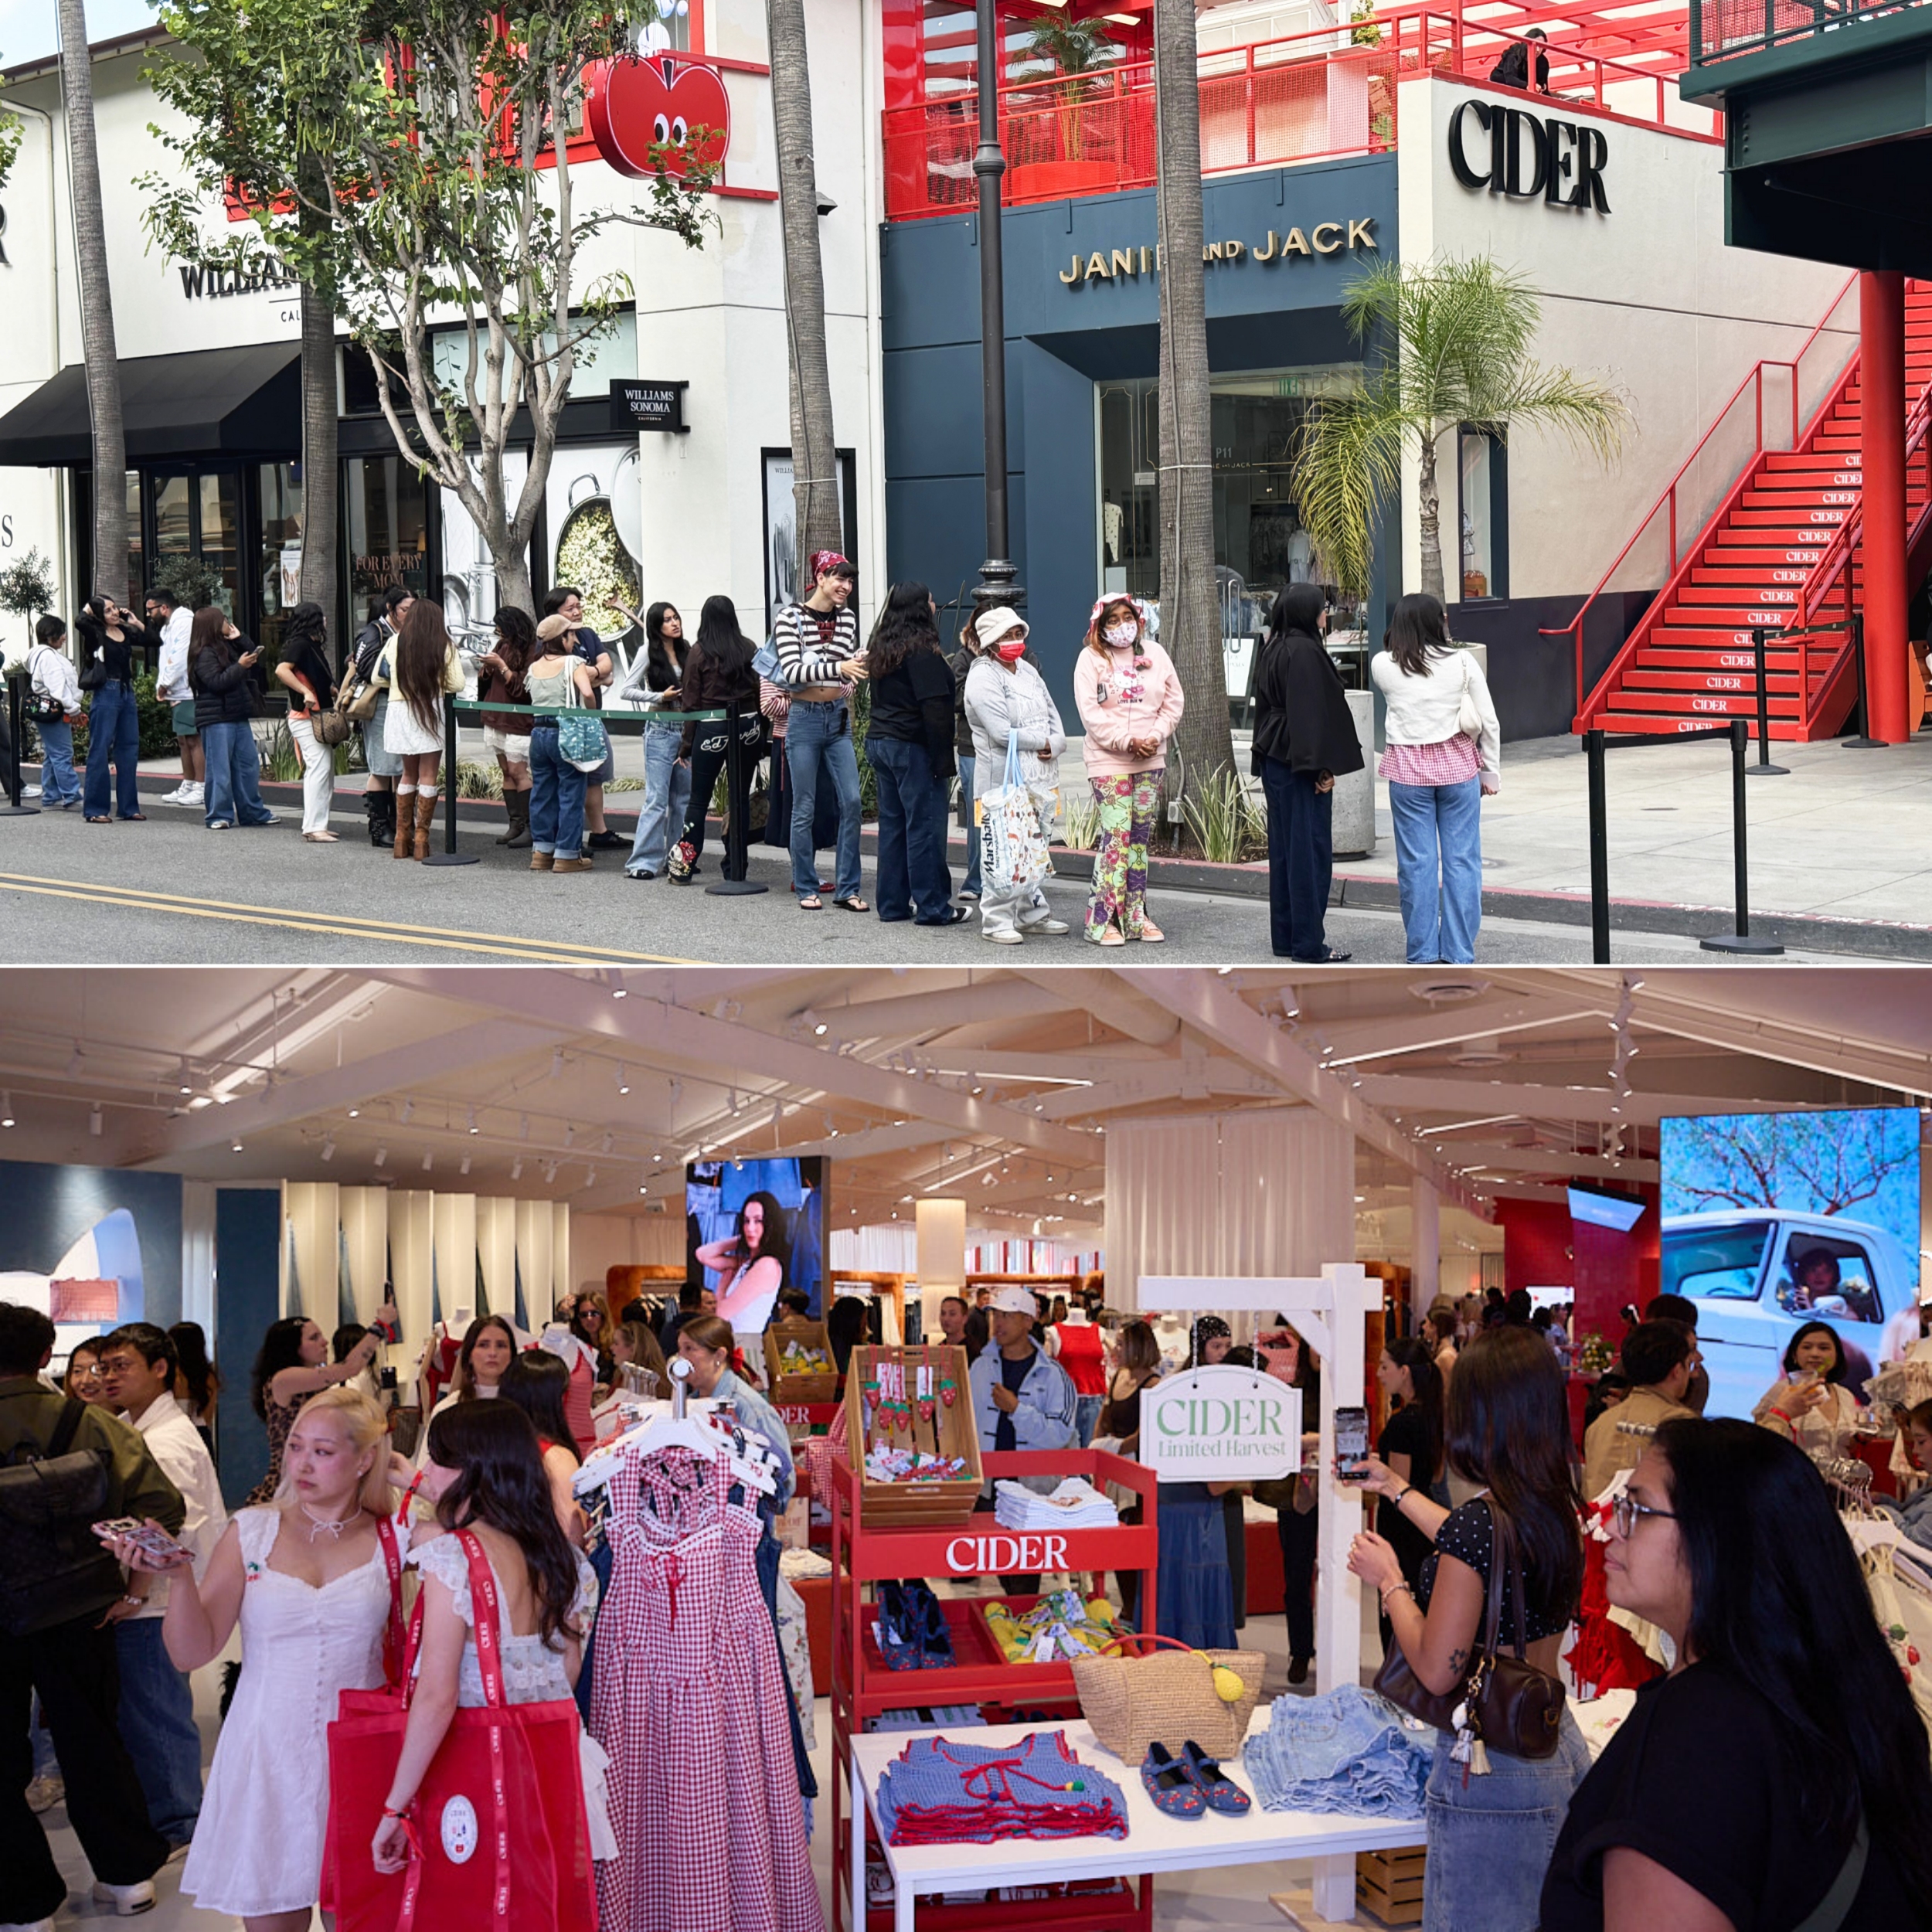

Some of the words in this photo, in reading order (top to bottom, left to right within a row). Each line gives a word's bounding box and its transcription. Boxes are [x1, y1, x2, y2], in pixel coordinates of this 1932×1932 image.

[1448, 99, 1612, 214] CIDER
[1253, 217, 1377, 260] JACK
[624, 389, 674, 401] WILLIAMS
[630, 401, 671, 413] SONOMA
[1822, 492, 1855, 503] CIDER
[1810, 512, 1843, 522] CIDER
[1798, 531, 1832, 542] CIDER
[355, 556, 380, 571] FOR
[382, 554, 421, 571] EVERY
[1786, 551, 1819, 562] CIDER
[373, 573, 404, 588] MOM
[1773, 570, 1807, 581] CIDER
[1760, 591, 1794, 601] CIDER
[1747, 612, 1781, 624] CIDER
[1720, 655, 1755, 667] CIDER
[1706, 677, 1741, 689] CIDER
[1692, 699, 1727, 711] CIDER
[981, 811, 996, 879] Marshalls
[1156, 1398, 1284, 1437] CIDER
[1158, 1439, 1221, 1458] Limited
[1226, 1439, 1286, 1458] Harvest
[946, 1535, 1070, 1572] CIDER
